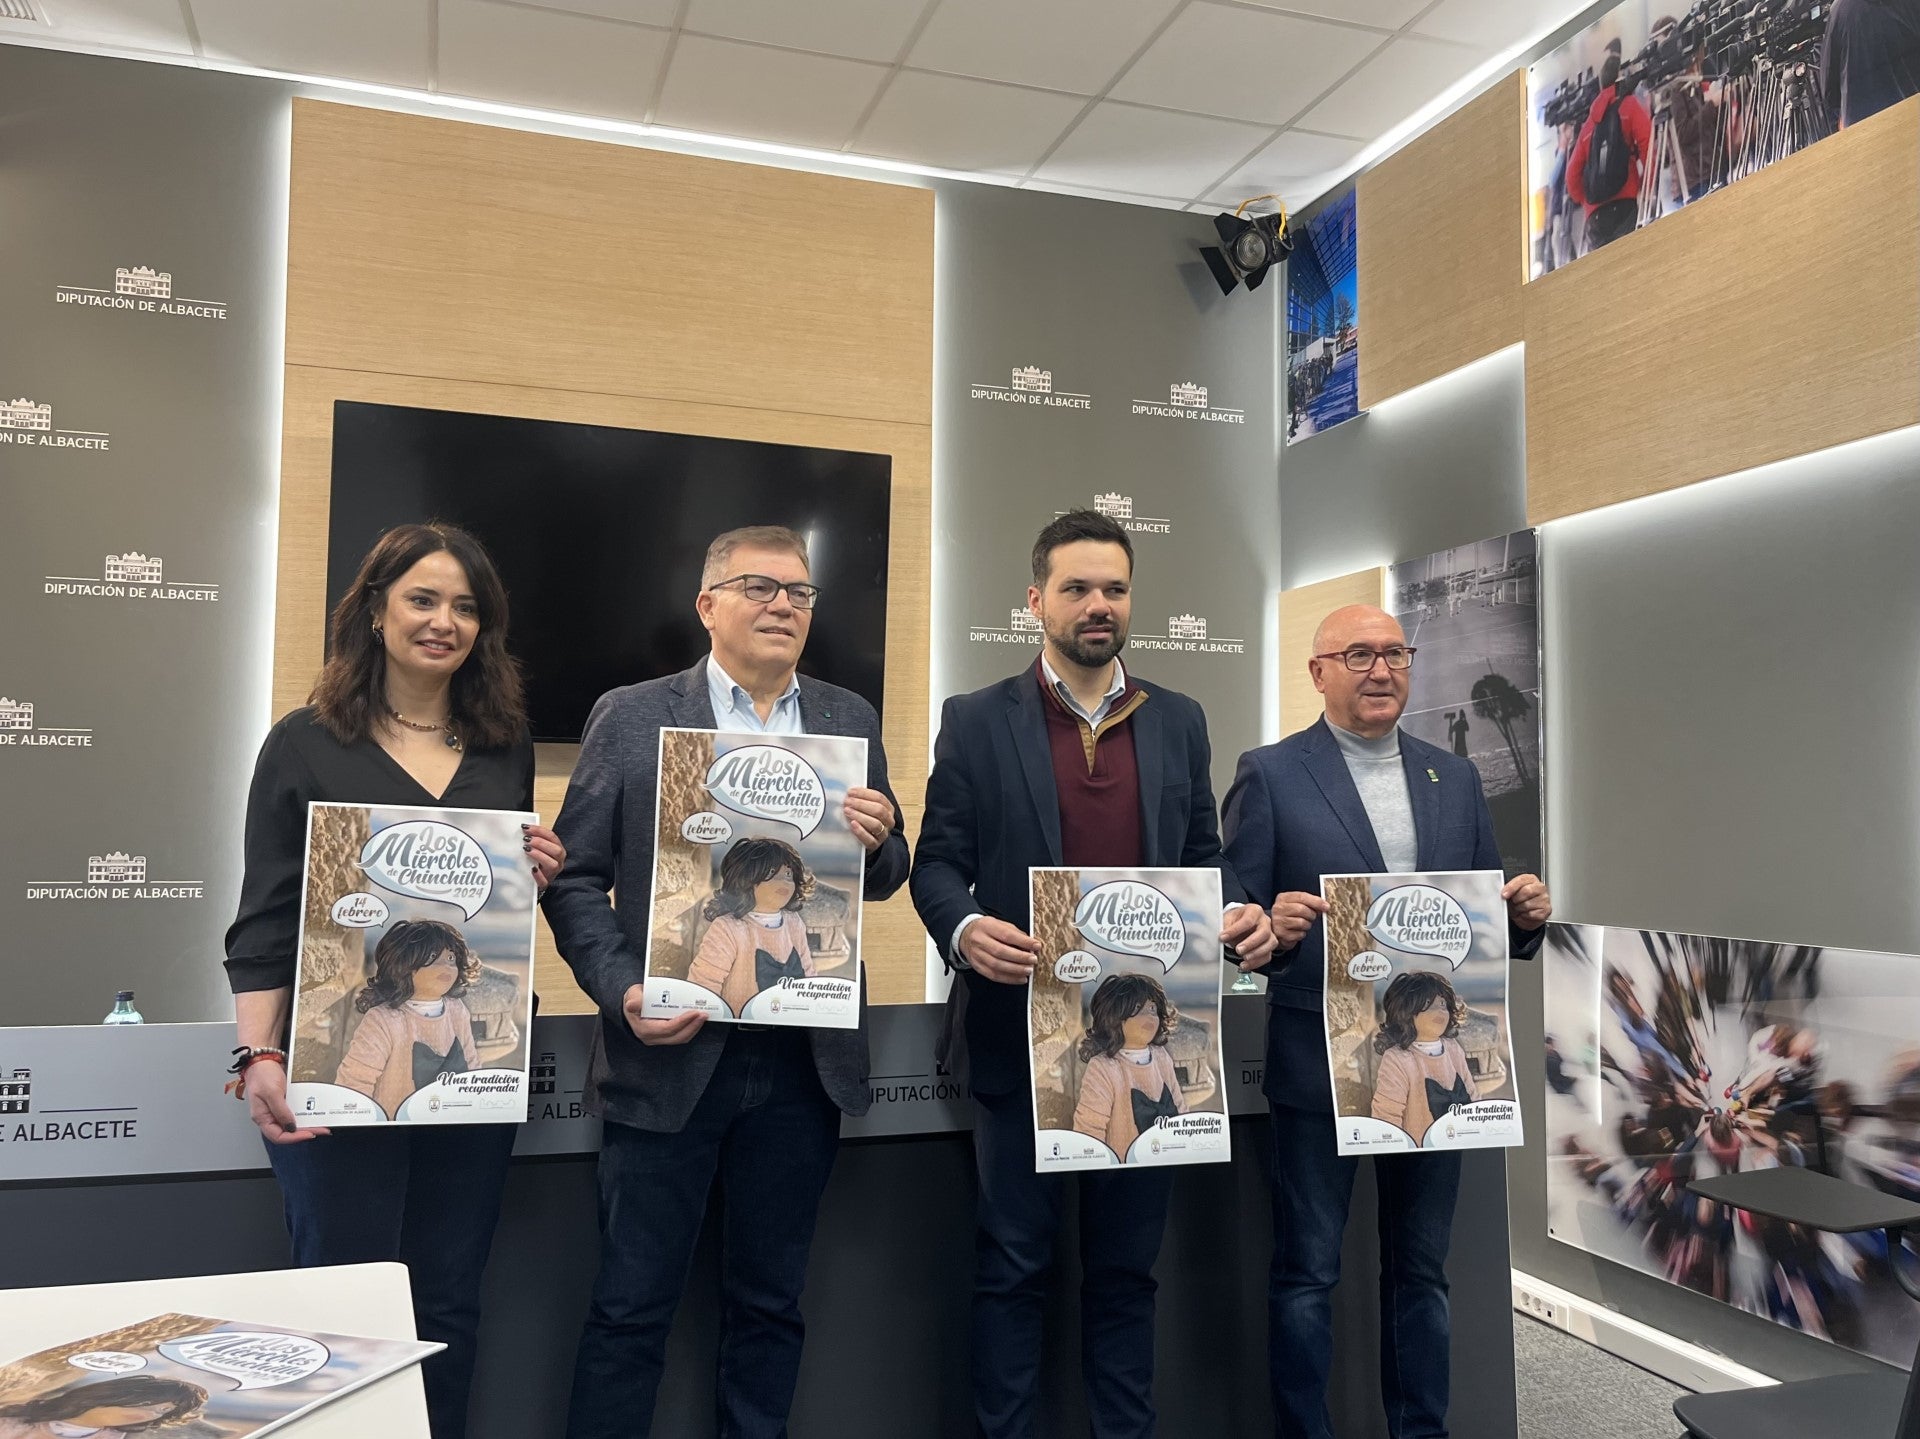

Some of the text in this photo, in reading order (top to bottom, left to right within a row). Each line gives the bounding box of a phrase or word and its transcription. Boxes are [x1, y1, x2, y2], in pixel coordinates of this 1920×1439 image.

[57, 292, 227, 320] DIPUTACIÓN DE ALBACETE
[971, 389, 1091, 410] DIPUTACIÓN DE ALBACETE
[1132, 405, 1245, 424] DIPUTACIÓN DE ALBACETE
[17, 434, 36, 445] DE
[39, 435, 110, 451] ALBACETE
[1125, 522, 1171, 534] ALBACETE
[45, 583, 219, 602] DIPUTACIÓN DE ALBACETE
[970, 632, 1041, 645] DIPUTACIÓN DE
[1131, 639, 1244, 654] DIPUTACIÓN DE ALBACETE
[0, 734, 93, 747] DE ALBACETE
[759, 750, 794, 776] Los
[740, 789, 822, 807] Chinchilla
[789, 808, 818, 820] 2024
[687, 822, 727, 836] febrero
[419, 825, 458, 852] Los
[398, 868, 488, 886] Chinchilla
[27, 886, 204, 899] DIPUTACIÓN DE ALBACETE
[453, 887, 483, 899] 2024
[1121, 886, 1154, 911] Los
[1410, 889, 1442, 913] Los
[337, 903, 383, 919] febrero
[1107, 925, 1181, 942] Chinchilla
[1397, 926, 1467, 943] Chinchilla
[1153, 942, 1179, 953] 2024
[1441, 942, 1466, 951] 2024
[1059, 963, 1097, 976] febrero
[1352, 962, 1388, 975] febrero
[778, 977, 852, 993] Una tradición
[797, 990, 852, 1001] recuperada!
[437, 1072, 521, 1087] Una tradición
[458, 1084, 520, 1095] recuperada!
[871, 1081, 960, 1103] IPUTACIÓN
[1449, 1104, 1513, 1116] Una tradición
[1155, 1117, 1222, 1129] Una tradición
[1467, 1113, 1514, 1123] recuperada!
[13, 1120, 138, 1142] ALBACETE
[1173, 1126, 1222, 1137] recuperada!
